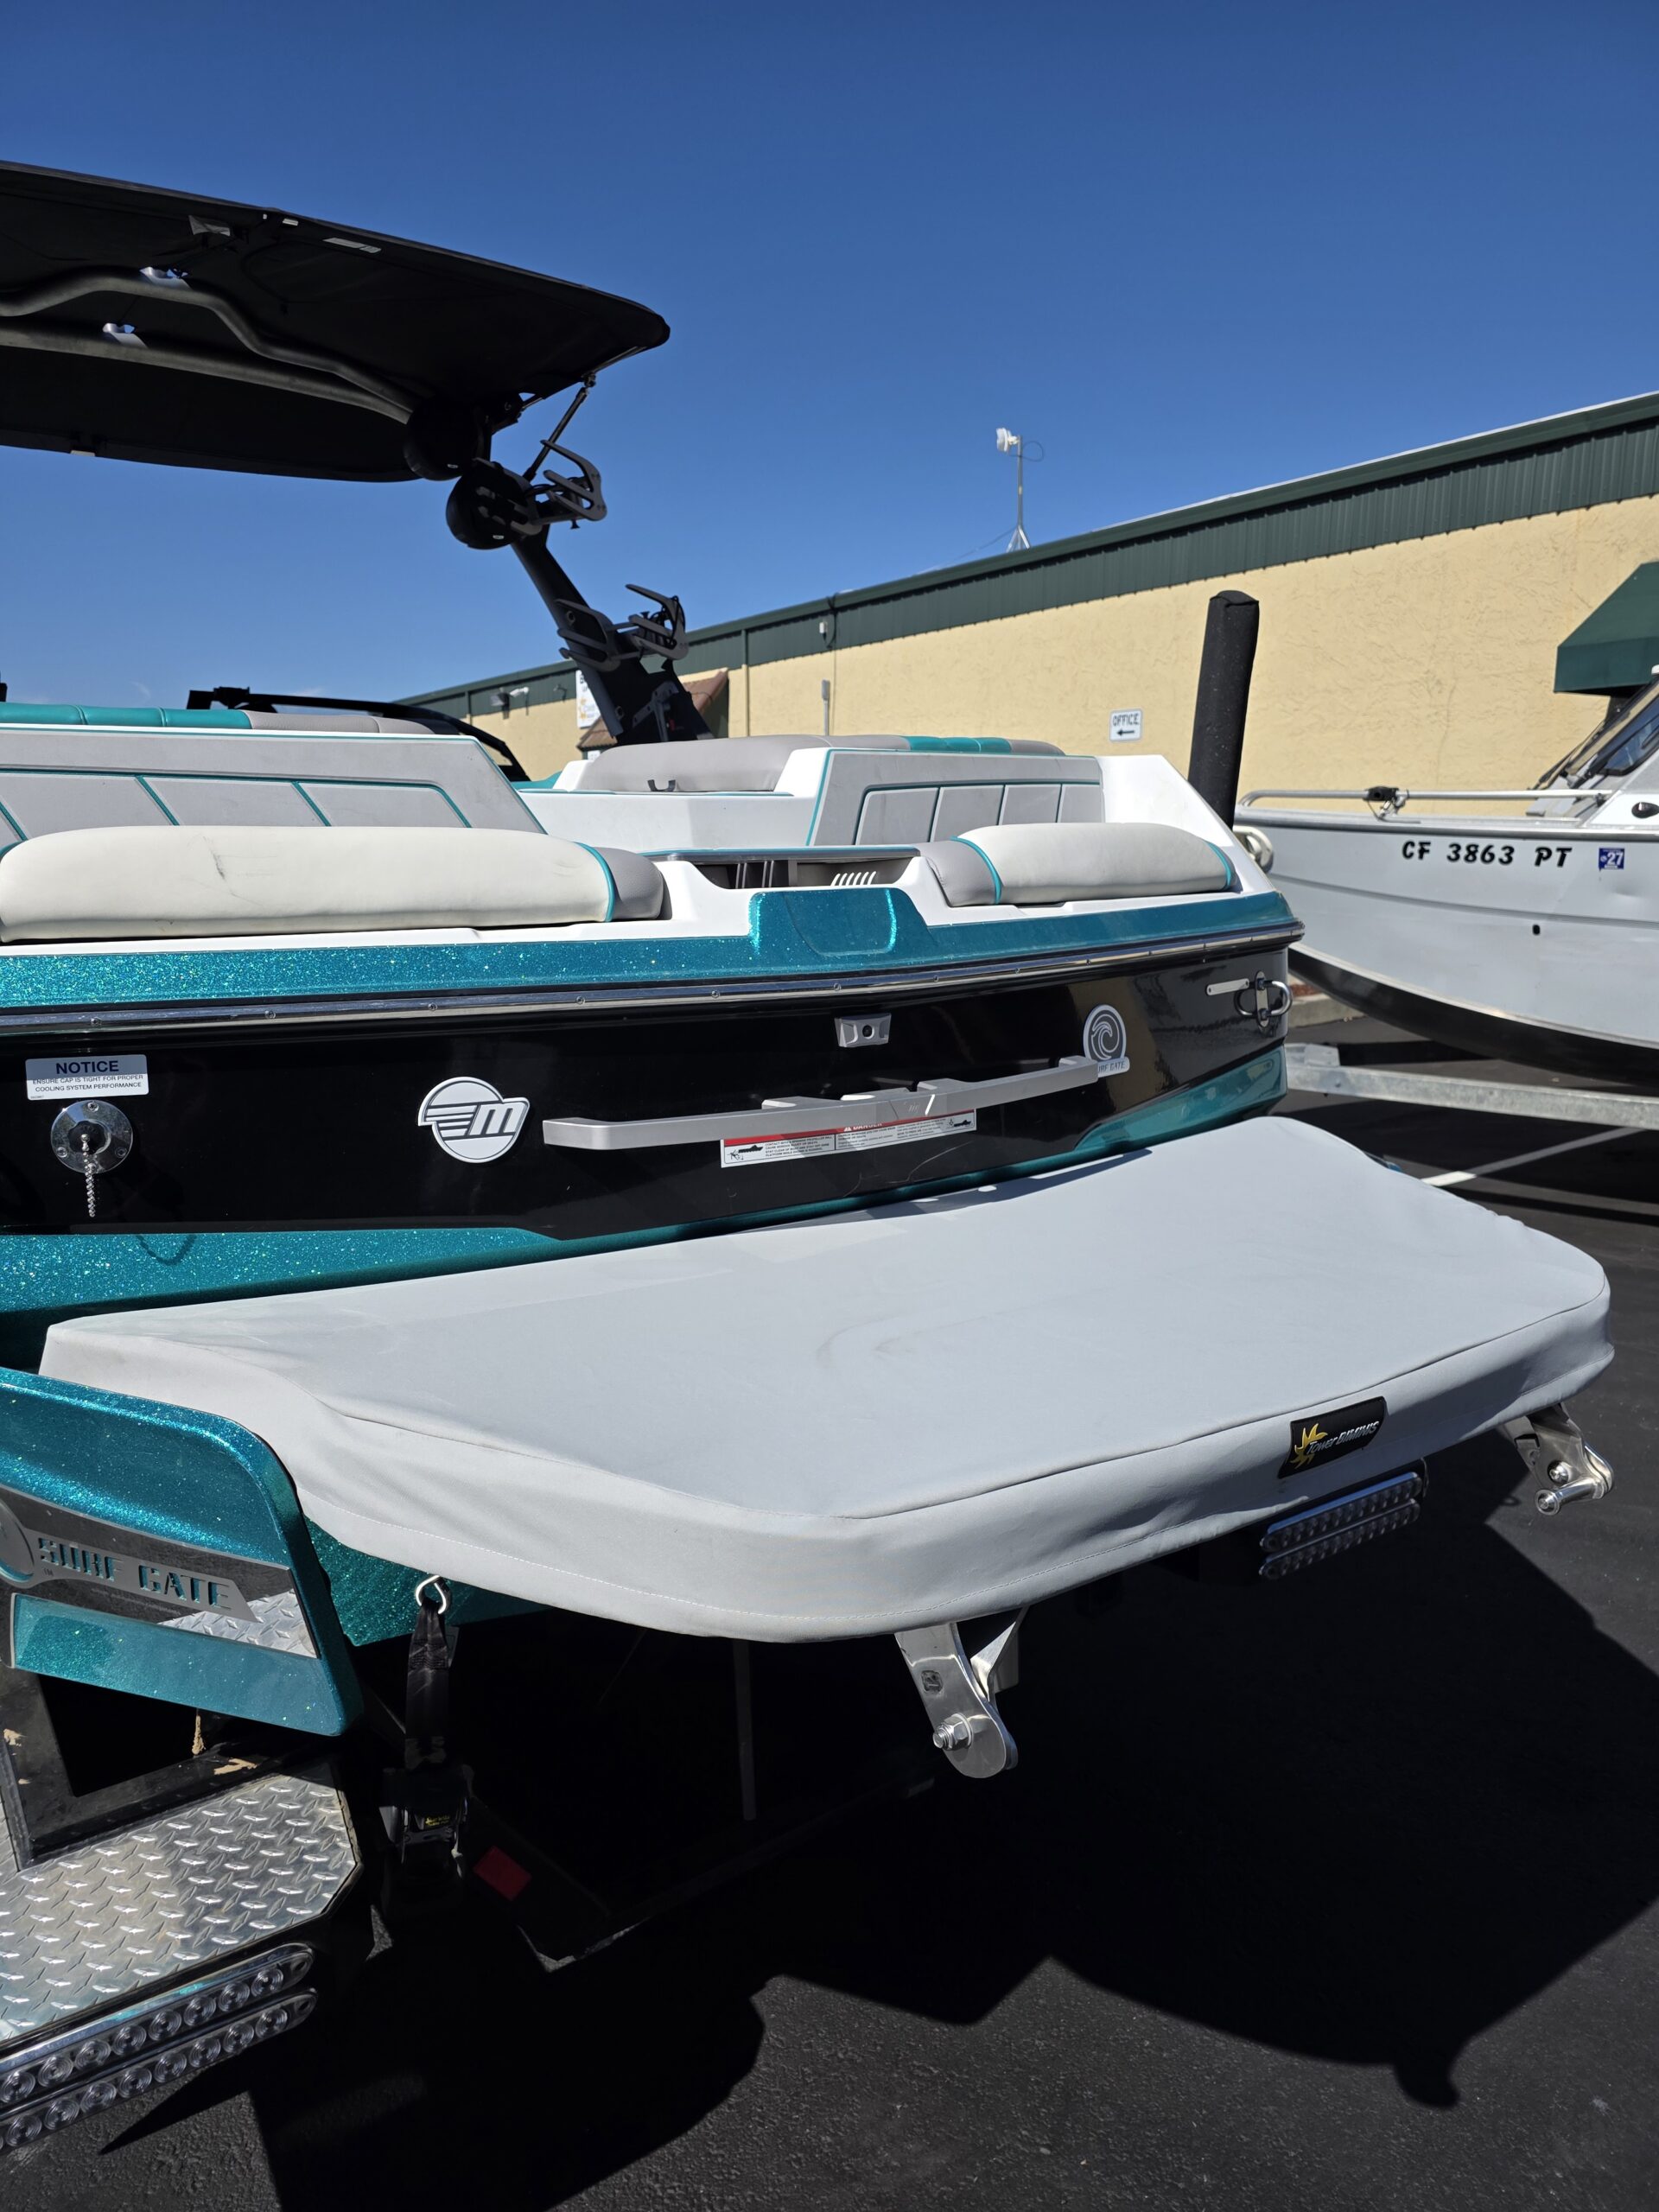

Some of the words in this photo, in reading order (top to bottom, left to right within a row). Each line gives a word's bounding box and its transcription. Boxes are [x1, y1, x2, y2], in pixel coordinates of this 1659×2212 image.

[1113, 713, 1140, 727] OFFICE
[1402, 841, 1432, 861] CF
[1446, 843, 1515, 865] 3863
[1534, 847, 1573, 868] PT
[1607, 851, 1624, 866] 27
[55, 1060, 119, 1074] NOTICE
[38, 1536, 125, 1582] SURF
[138, 1564, 232, 1610] GATE
